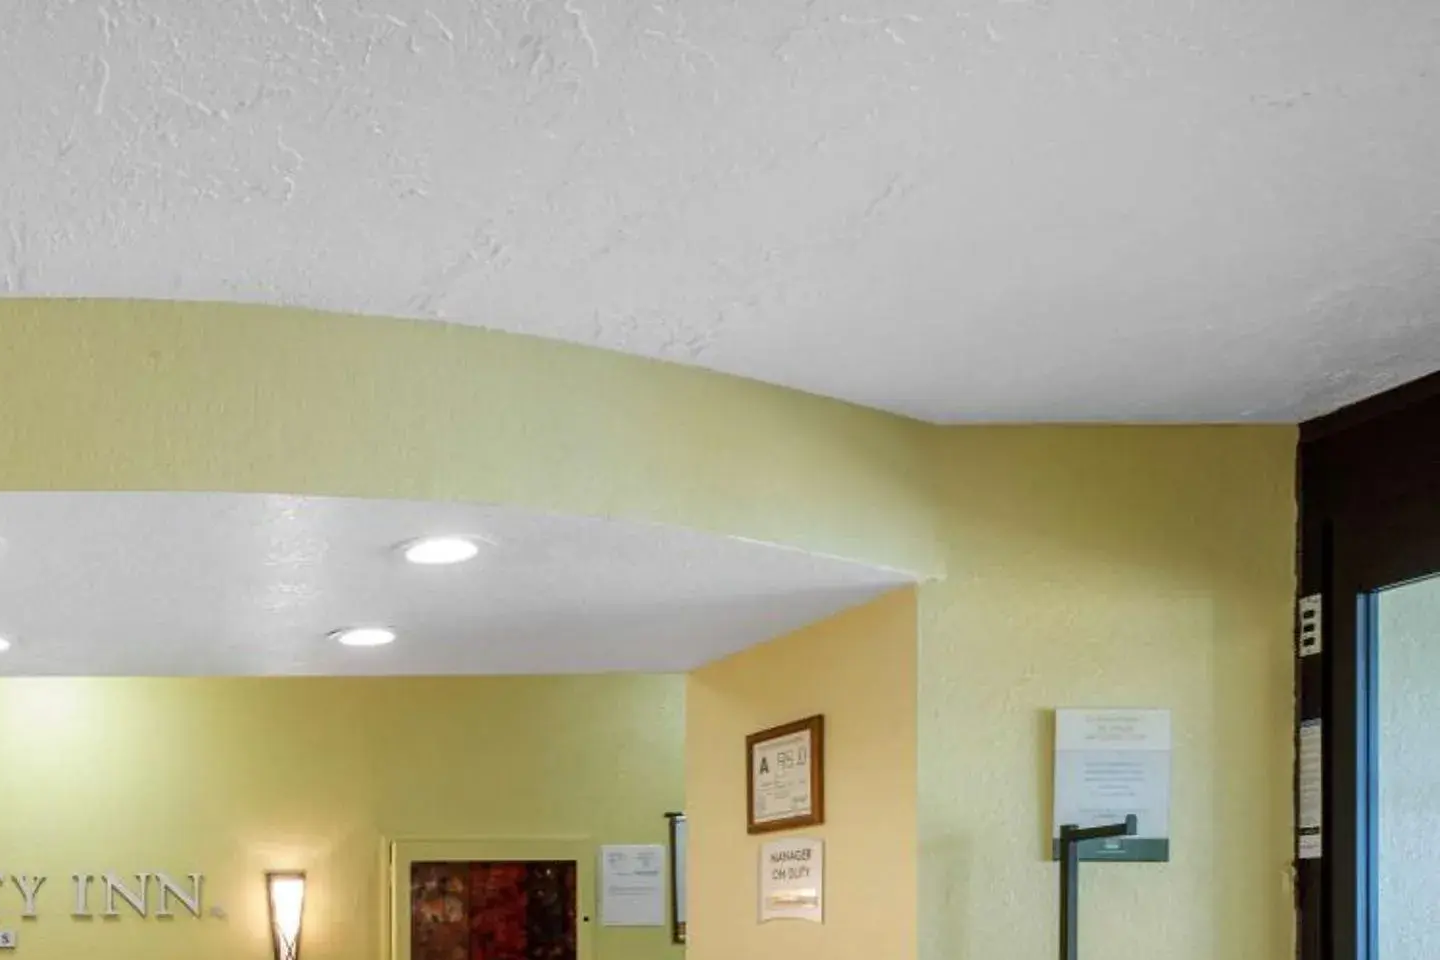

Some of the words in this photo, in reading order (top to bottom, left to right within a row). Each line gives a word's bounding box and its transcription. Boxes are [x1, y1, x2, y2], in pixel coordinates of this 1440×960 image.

[760, 756, 770, 775] A
[770, 848, 812, 863] MANAGER
[789, 864, 810, 880] DUTY
[72, 872, 205, 919] INN
